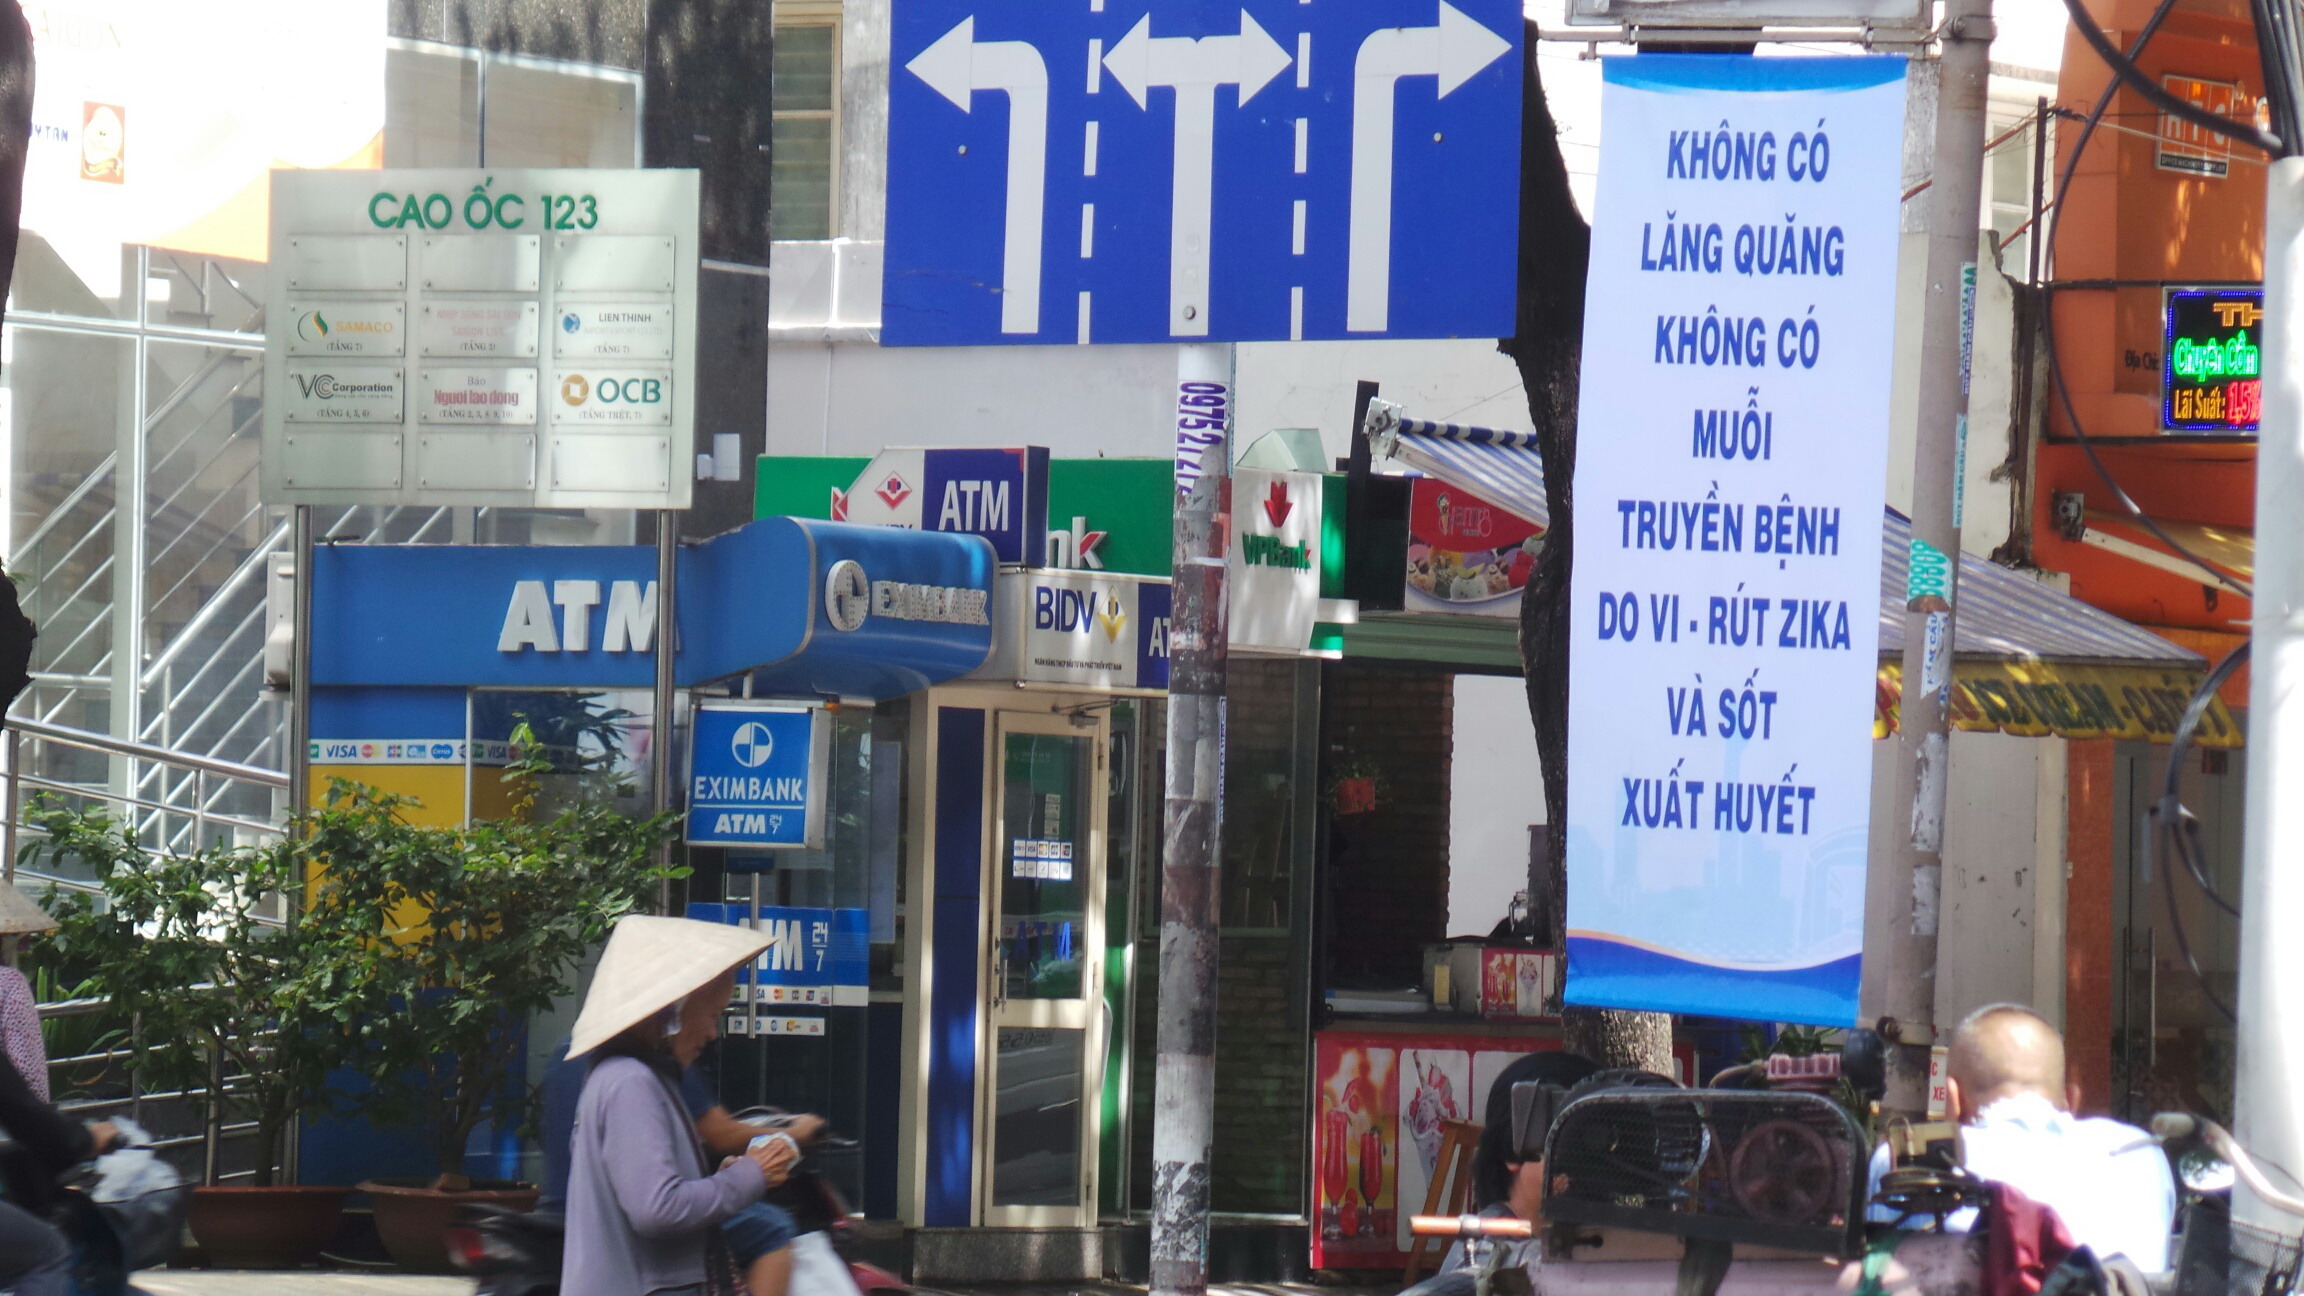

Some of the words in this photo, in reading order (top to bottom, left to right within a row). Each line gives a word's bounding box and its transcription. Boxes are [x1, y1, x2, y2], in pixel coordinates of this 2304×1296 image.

[1667, 119, 1776, 182] KHÔNG
[1787, 118, 1830, 183] CÓ
[368, 192, 453, 230] CAO
[463, 177, 524, 230] ỐC
[541, 194, 599, 230] 123
[1641, 210, 1723, 274] LĂNG
[1734, 212, 1845, 278] QUĂNG
[1654, 304, 1766, 368] KHÔNG
[1777, 304, 1820, 369] CÓ
[2174, 337, 2225, 382] Chuyên
[595, 378, 662, 403] OCB
[2174, 389, 2193, 420] Lãi
[1692, 386, 1772, 461] MUỖI
[938, 480, 1010, 532] ATM
[1617, 480, 1744, 553] TRUYỀN
[1754, 493, 1841, 570] BỆNH
[1242, 532, 1312, 573] VPBank
[496, 580, 681, 653] ATM
[1035, 586, 1098, 634] BIDV
[1598, 591, 1640, 643] DO
[1650, 593, 1680, 643] VI
[1708, 582, 1771, 647] RÚT
[1778, 598, 1852, 651] ZIKA
[1148, 617, 1171, 658] AT
[1667, 673, 1707, 737] VÀ
[1718, 668, 1778, 741] SỐT
[326, 744, 358, 759] VISA
[694, 775, 804, 802] EXIMBANK
[1621, 757, 1705, 830] XUẤT
[1714, 763, 1816, 836] HUYẾT
[714, 813, 766, 834] ATM
[812, 921, 828, 943] 24
[815, 949, 824, 972] 7
